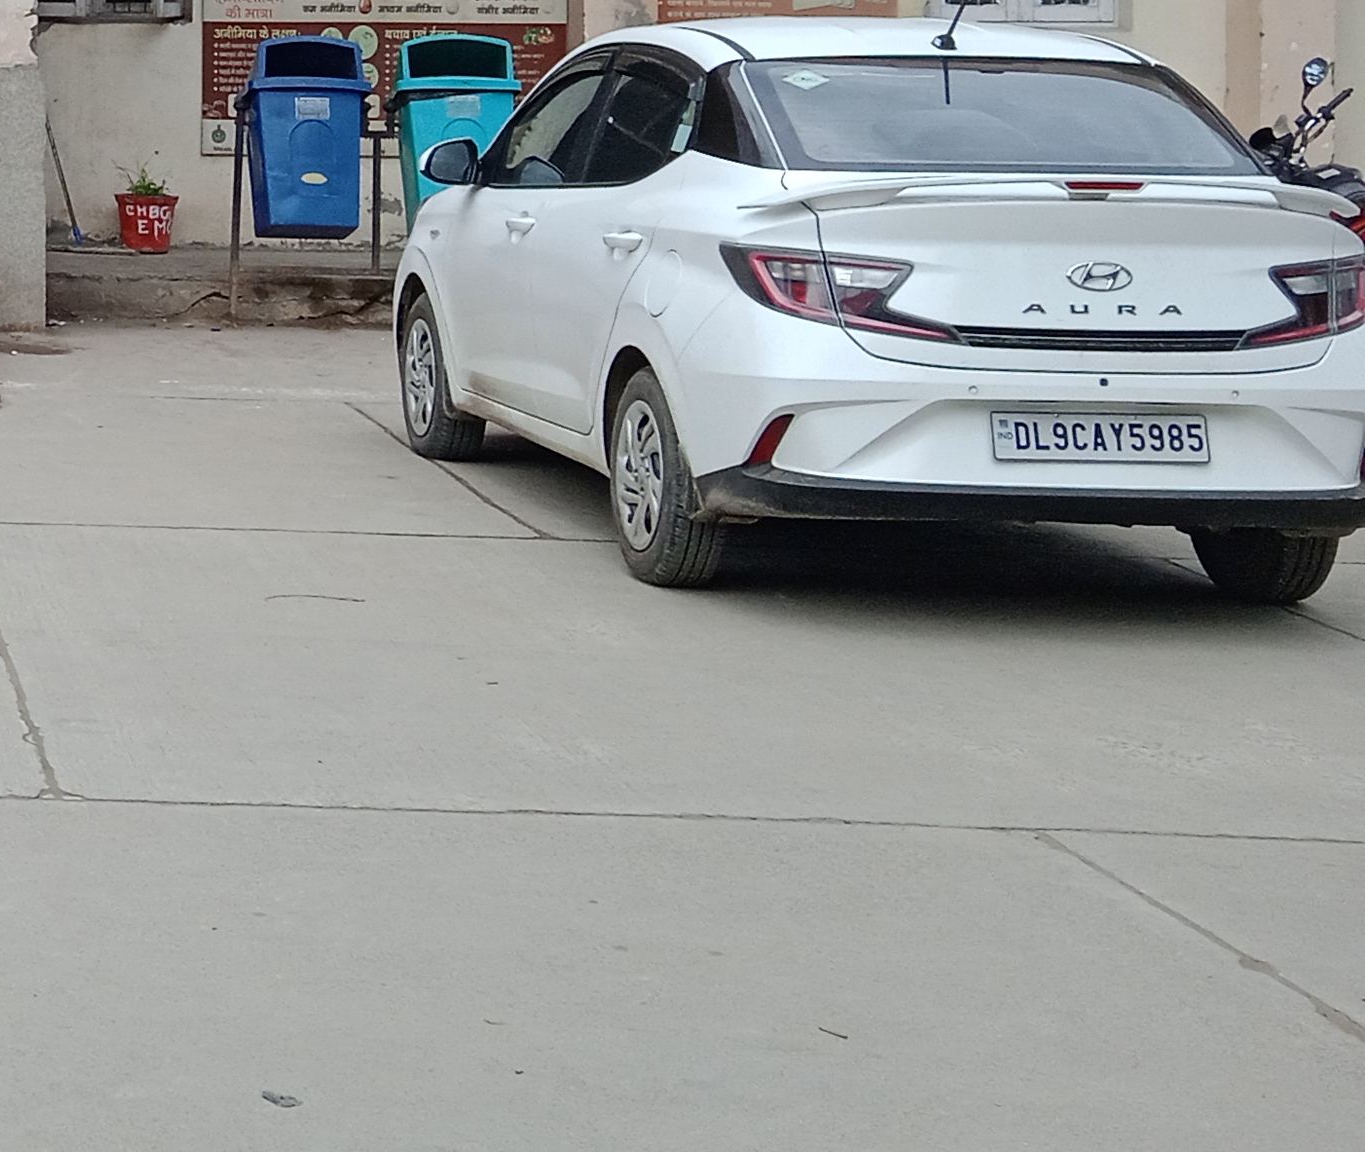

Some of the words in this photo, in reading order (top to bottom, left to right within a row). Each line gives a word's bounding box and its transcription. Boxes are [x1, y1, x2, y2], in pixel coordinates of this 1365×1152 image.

[225, 5, 241, 19] की
[213, 26, 257, 39] अनीमिया
[1022, 303, 1183, 316] AURA
[997, 432, 1013, 440] IND
[1013, 421, 1204, 452] DL9CAY5985
